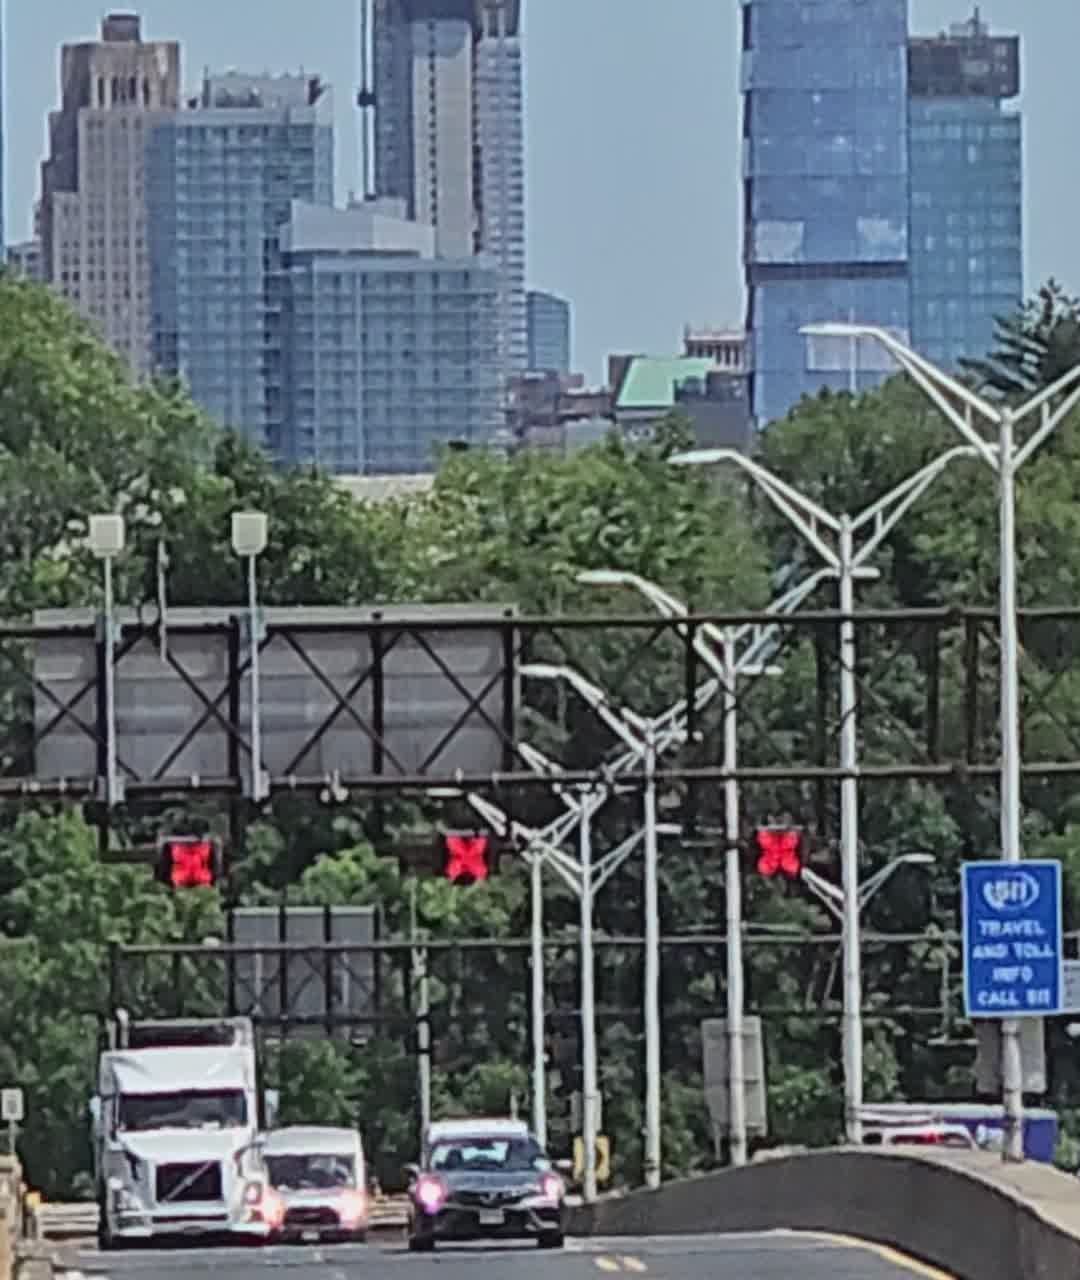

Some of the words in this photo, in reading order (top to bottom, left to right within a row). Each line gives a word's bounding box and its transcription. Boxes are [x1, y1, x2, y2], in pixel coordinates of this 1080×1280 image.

[978, 919, 1046, 936] TRAVEL
[972, 942, 1008, 959] AND
[1013, 942, 1055, 960] TOLL
[993, 965, 1033, 984] INFO
[977, 989, 1020, 1007] CALL
